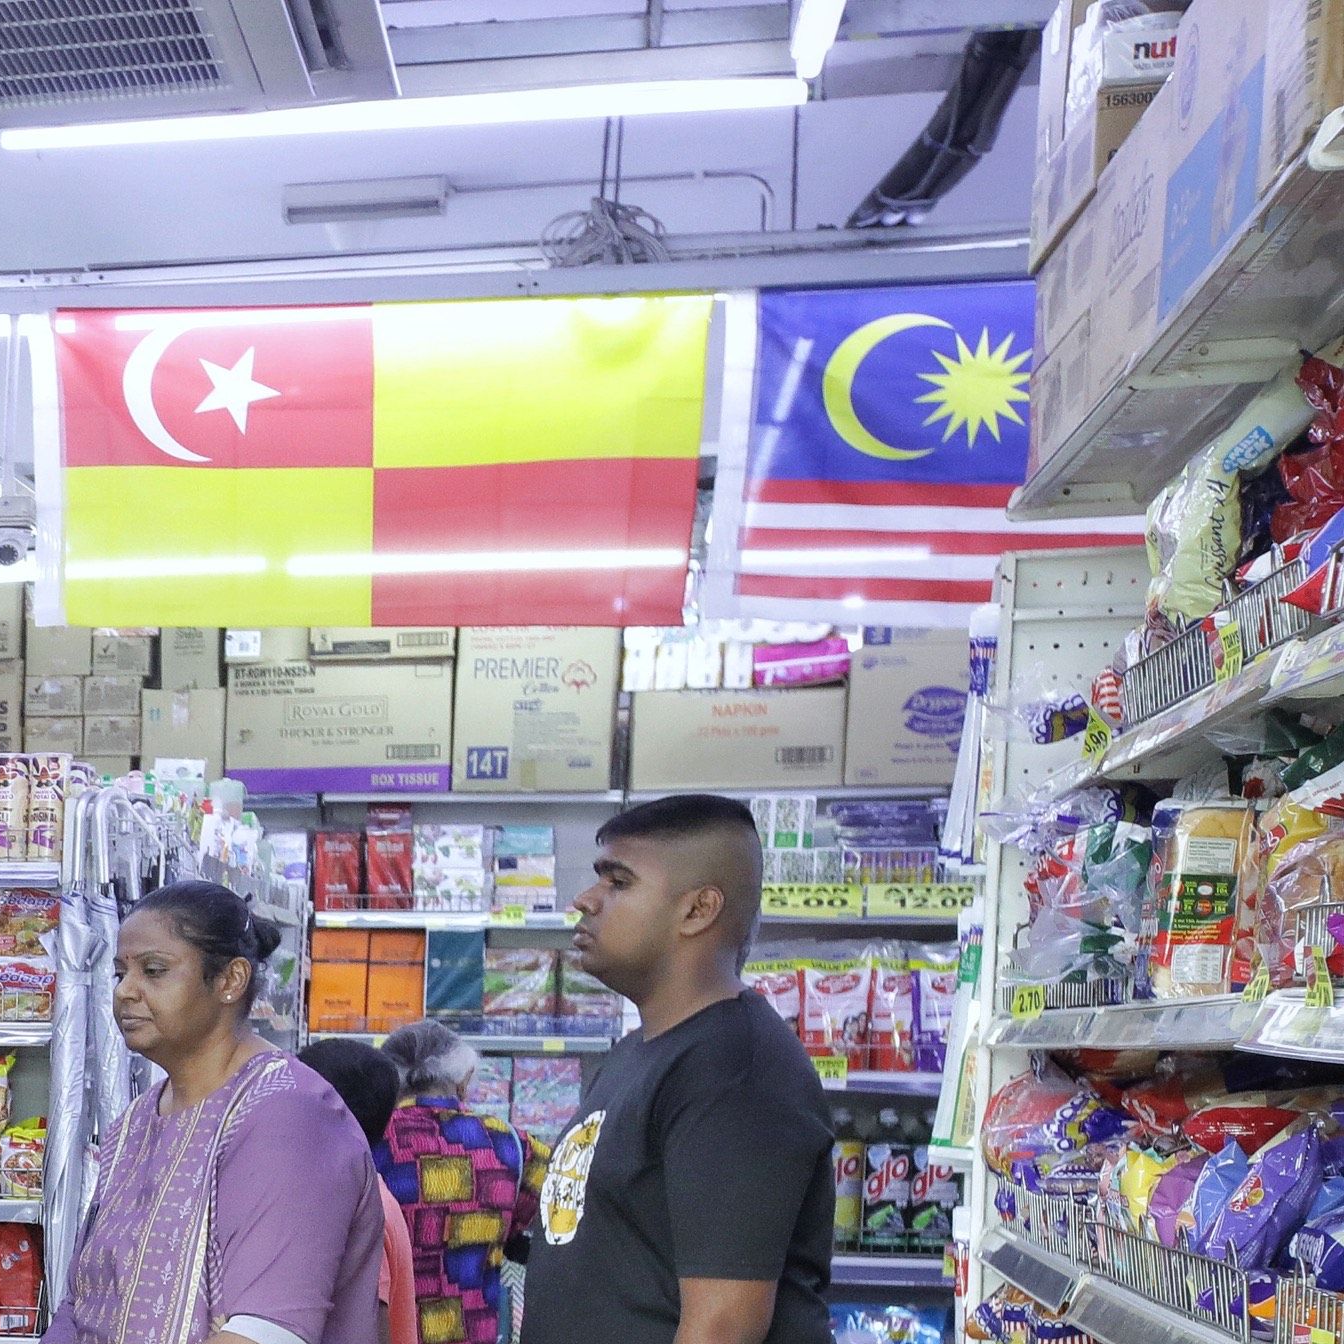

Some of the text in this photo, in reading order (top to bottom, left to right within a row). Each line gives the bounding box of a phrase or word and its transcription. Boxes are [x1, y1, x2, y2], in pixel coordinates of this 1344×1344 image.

[473, 656, 560, 680] PREMIER
[712, 702, 768, 717] NAPKIN
[468, 750, 508, 777] 14T
[371, 772, 440, 785] BOX TISSUE
[866, 1157, 909, 1201] glo
